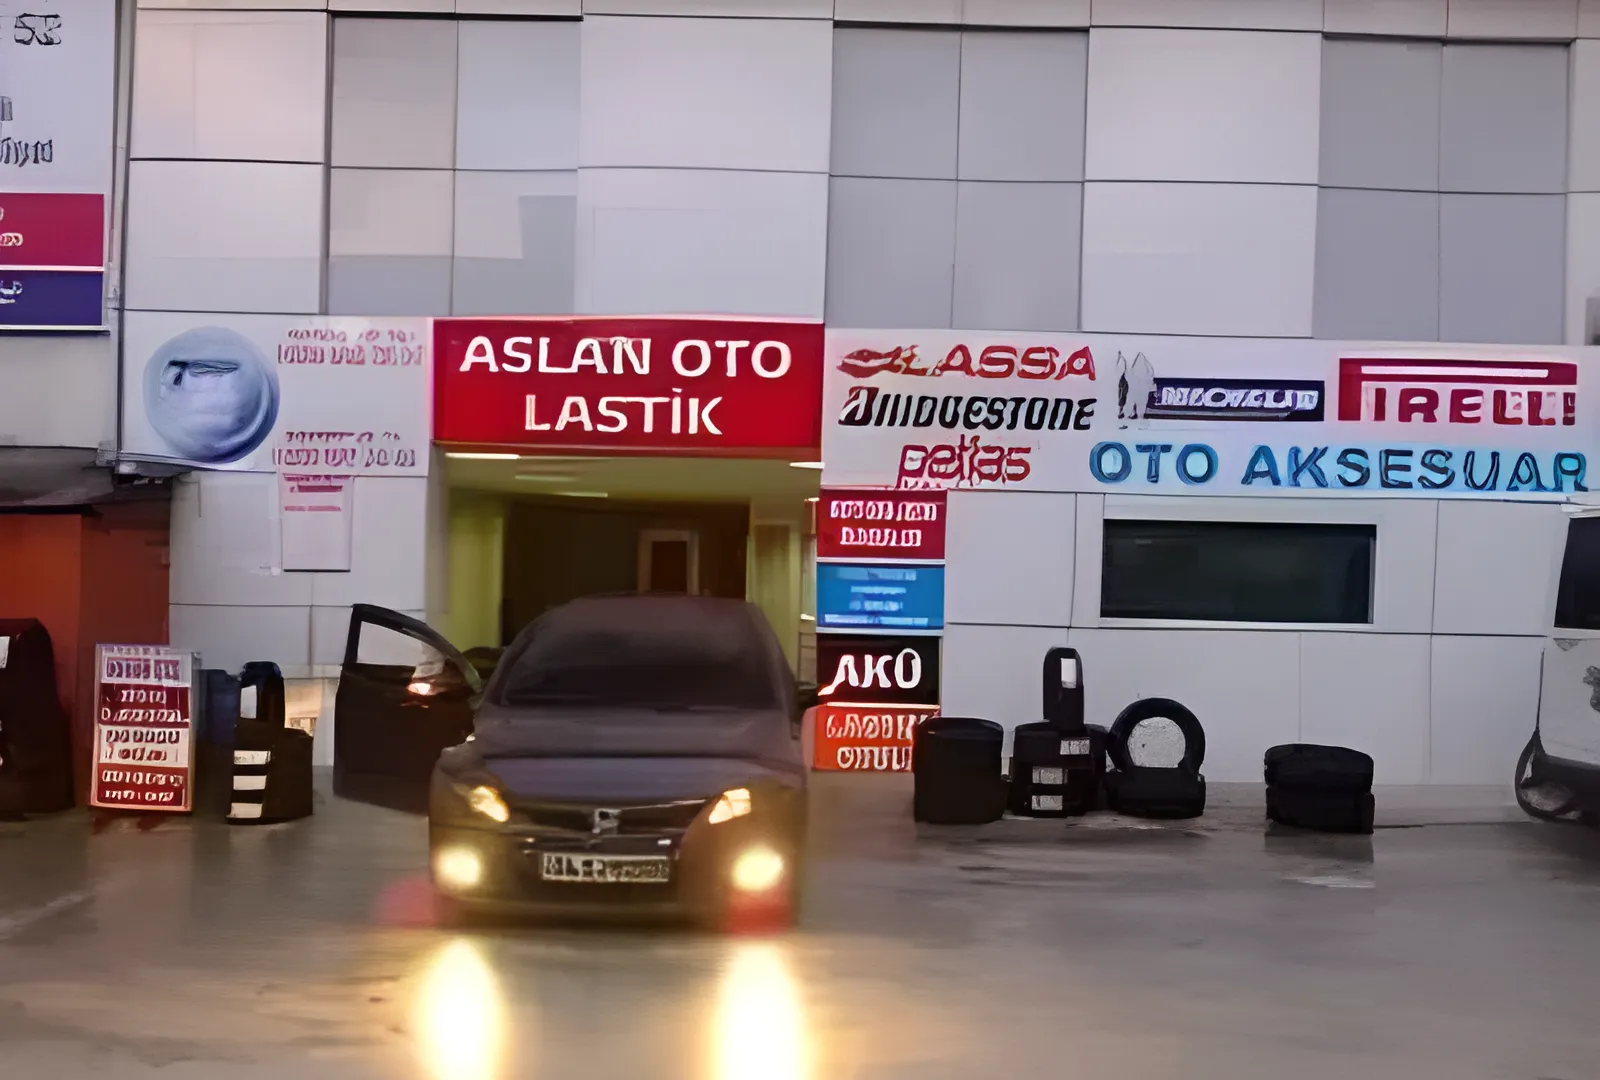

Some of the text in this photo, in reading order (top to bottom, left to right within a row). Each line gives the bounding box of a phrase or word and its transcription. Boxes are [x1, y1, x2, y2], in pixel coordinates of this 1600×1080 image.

[459, 335, 652, 375] ASLAN
[671, 338, 792, 379] OTO
[898, 343, 1097, 381] LASSA
[524, 388, 723, 435] LASTİK
[1338, 358, 1577, 426] PIRELLI
[1089, 441, 1589, 492] OTO AKSESUAR
[817, 647, 922, 696] AKO
